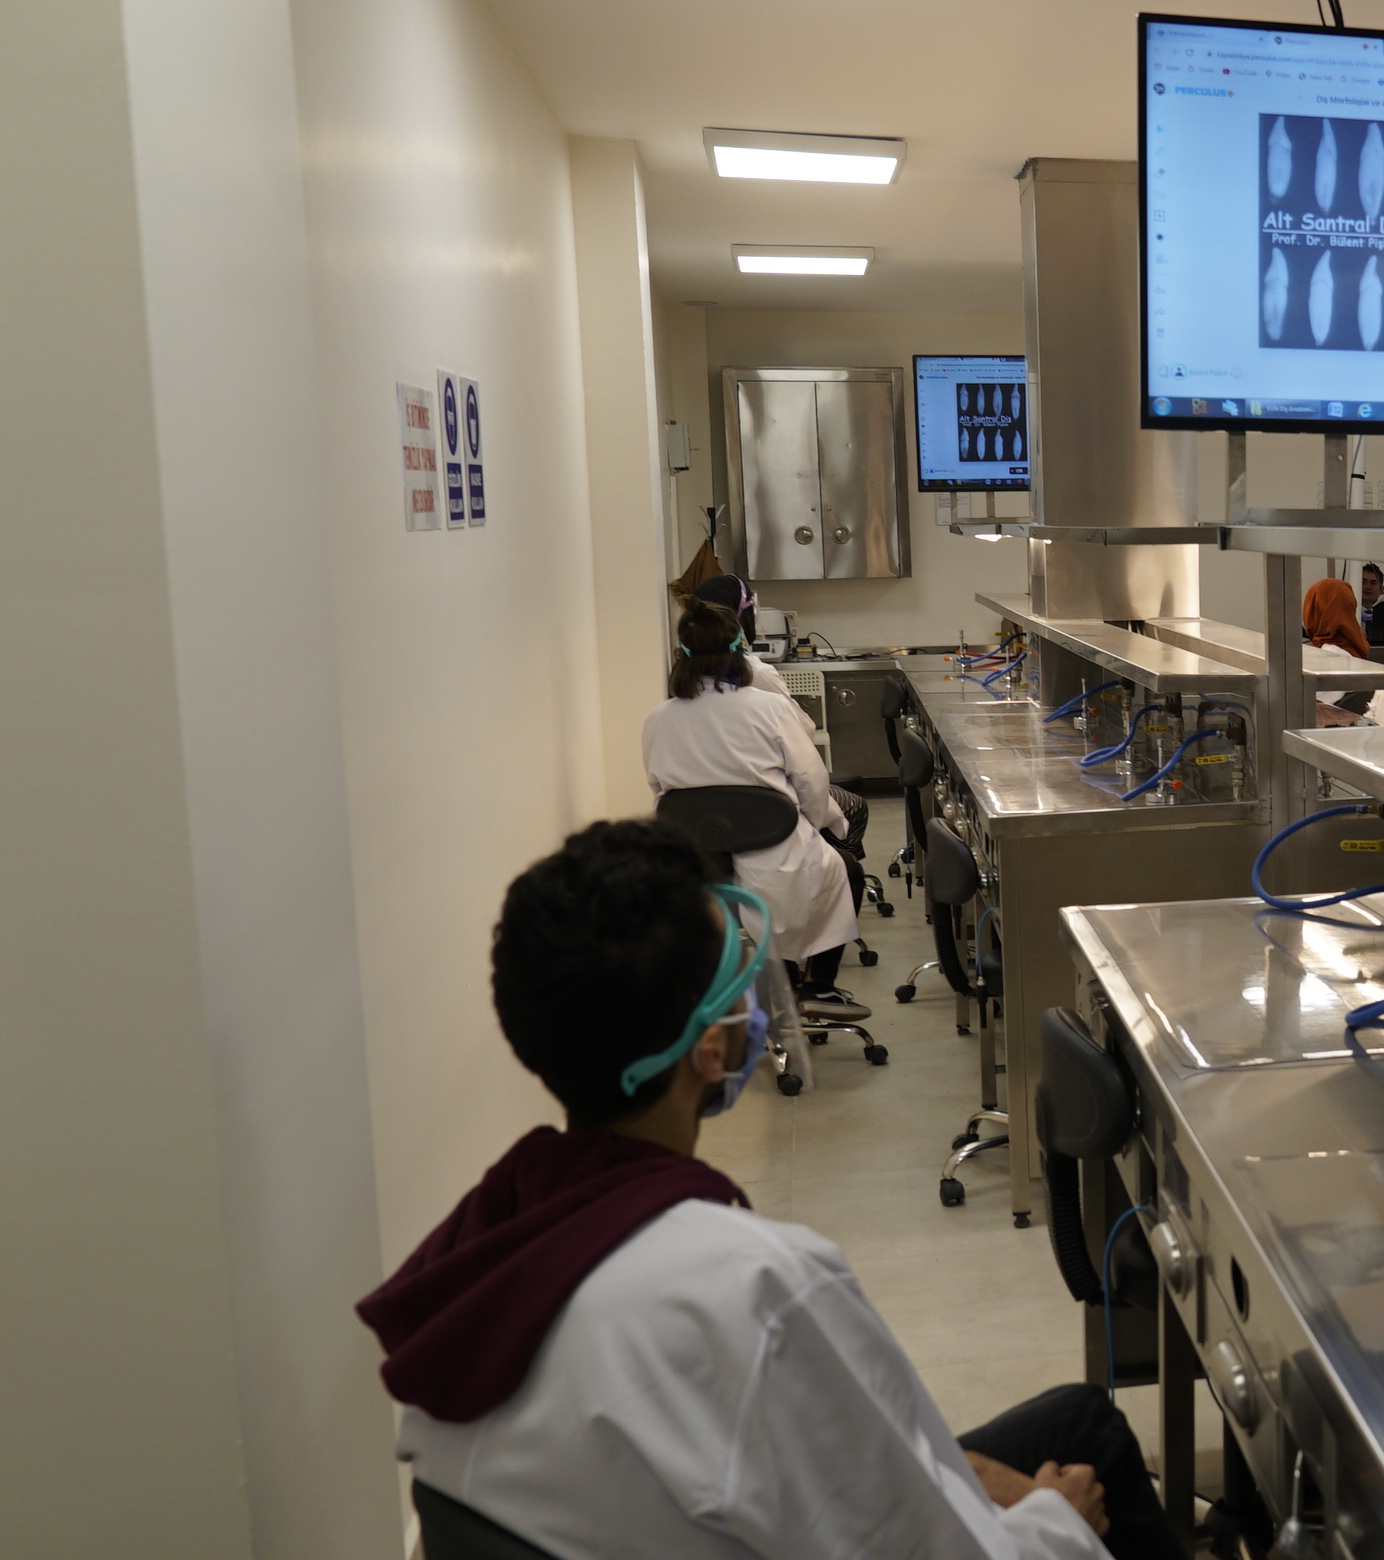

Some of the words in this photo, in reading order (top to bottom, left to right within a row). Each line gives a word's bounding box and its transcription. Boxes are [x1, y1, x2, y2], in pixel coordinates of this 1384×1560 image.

[1263, 210, 1293, 229] Alt
[1301, 212, 1370, 233] Santral
[1272, 233, 1300, 246] Prof.
[1306, 235, 1324, 246] Dr.
[1330, 236, 1364, 247] Bülent
